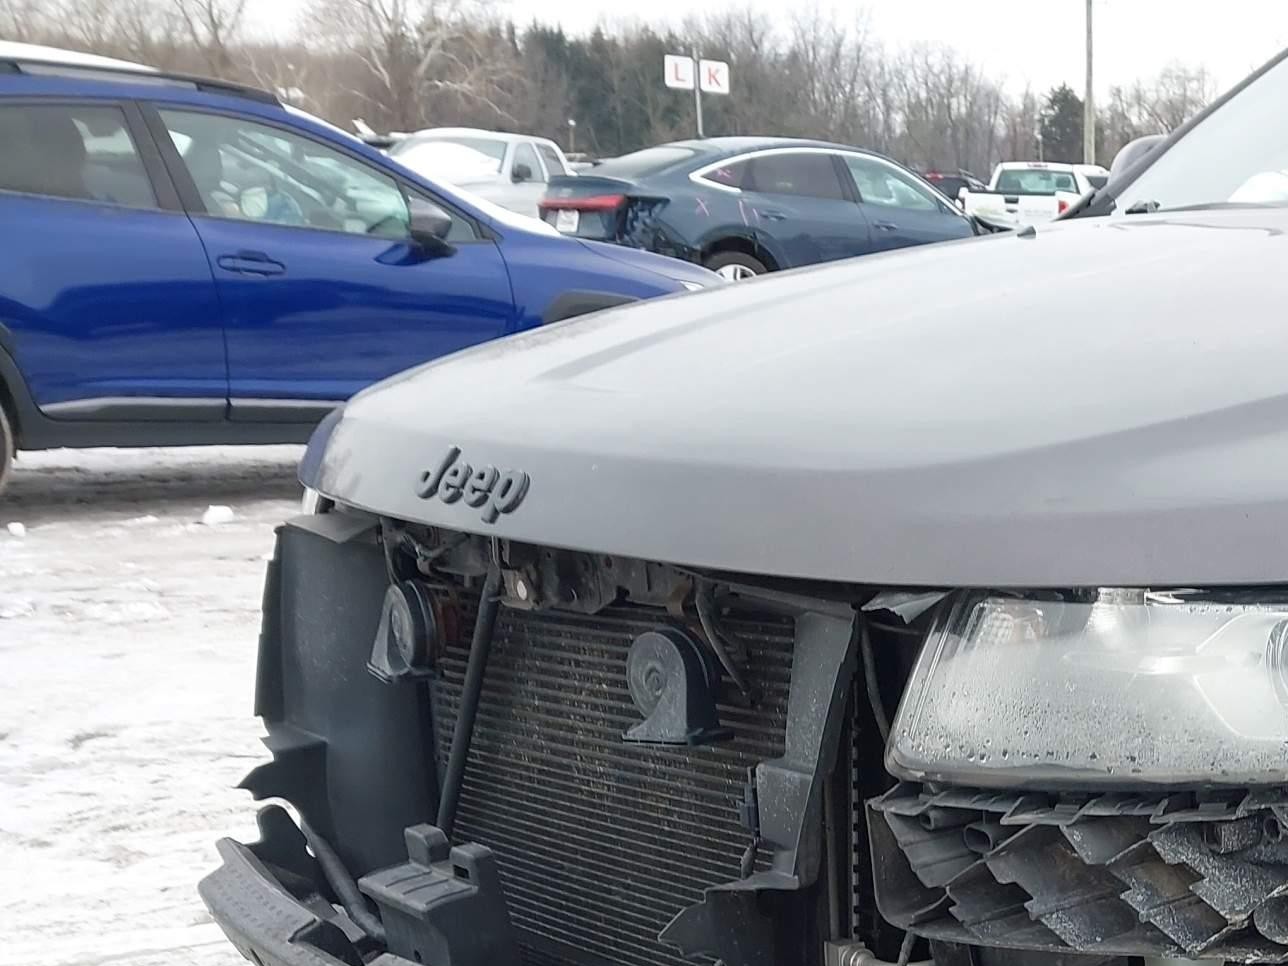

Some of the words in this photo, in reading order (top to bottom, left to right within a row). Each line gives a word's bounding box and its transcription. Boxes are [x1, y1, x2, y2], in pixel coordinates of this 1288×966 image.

[674, 63, 687, 82] L
[708, 66, 721, 87] K
[416, 445, 531, 525] Jeep
